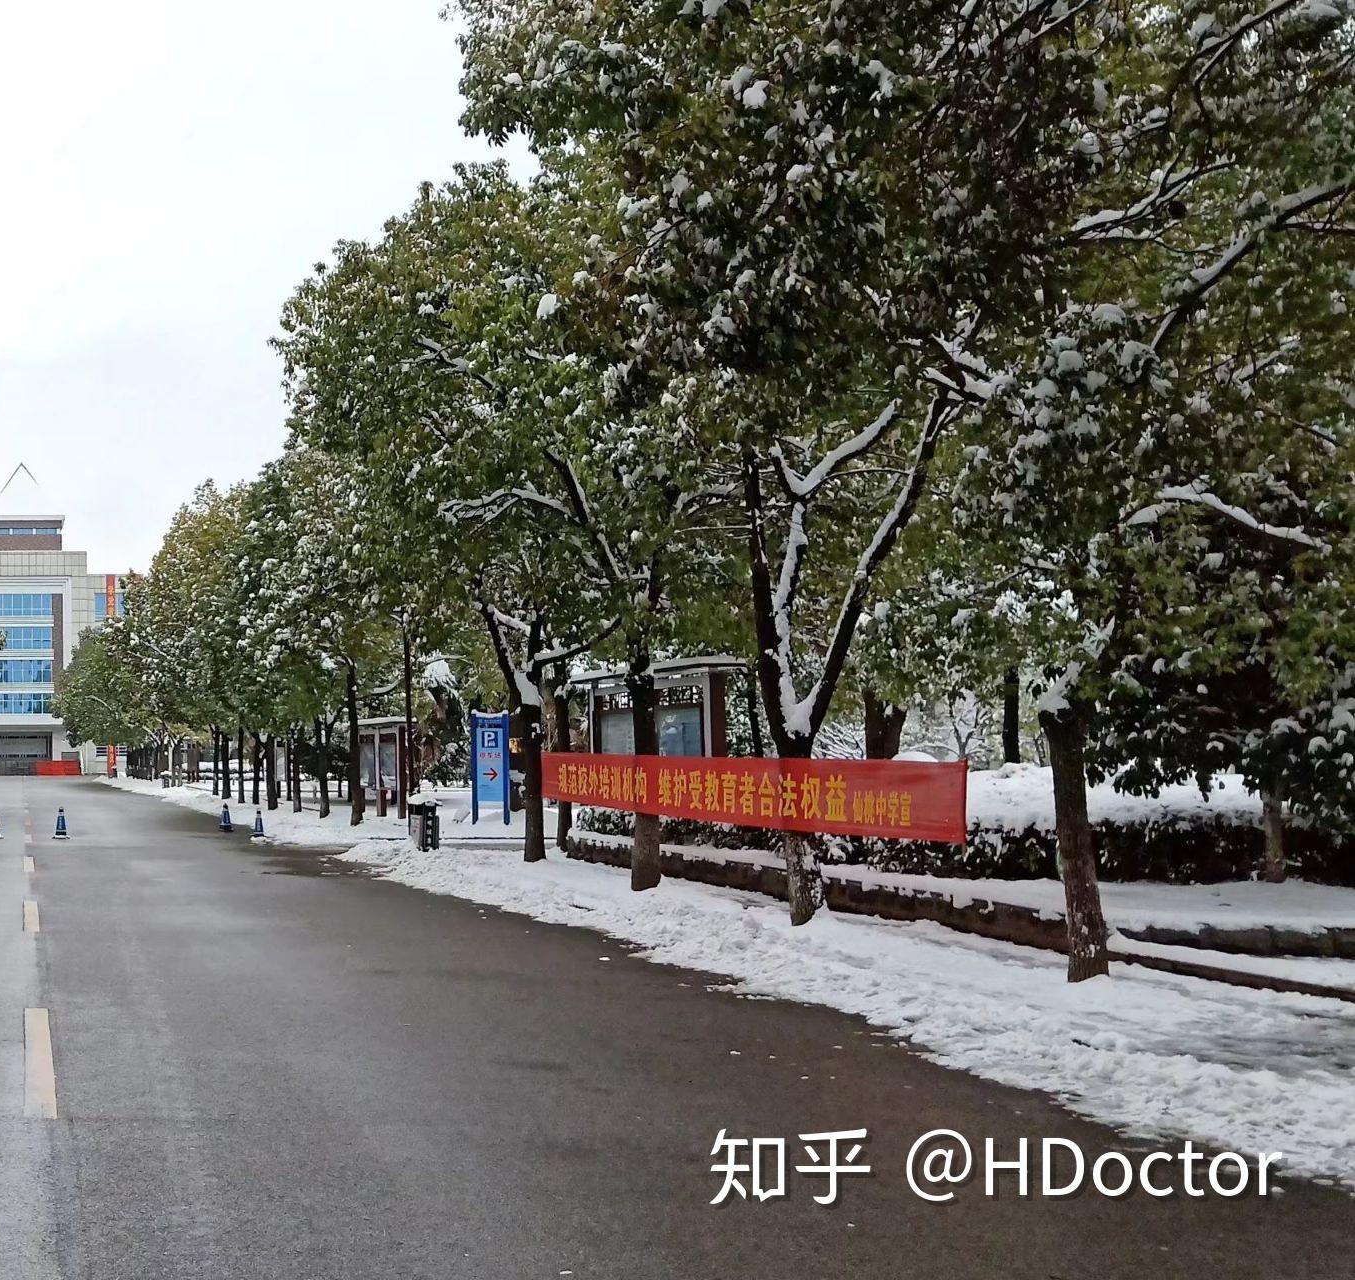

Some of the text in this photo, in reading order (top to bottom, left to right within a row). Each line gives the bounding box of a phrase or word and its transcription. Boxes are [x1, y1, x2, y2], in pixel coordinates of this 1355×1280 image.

[484, 731, 496, 747] P
[558, 763, 912, 826] 规范校外培训机构 维护受教育者合法权益 仙桃中学宣
